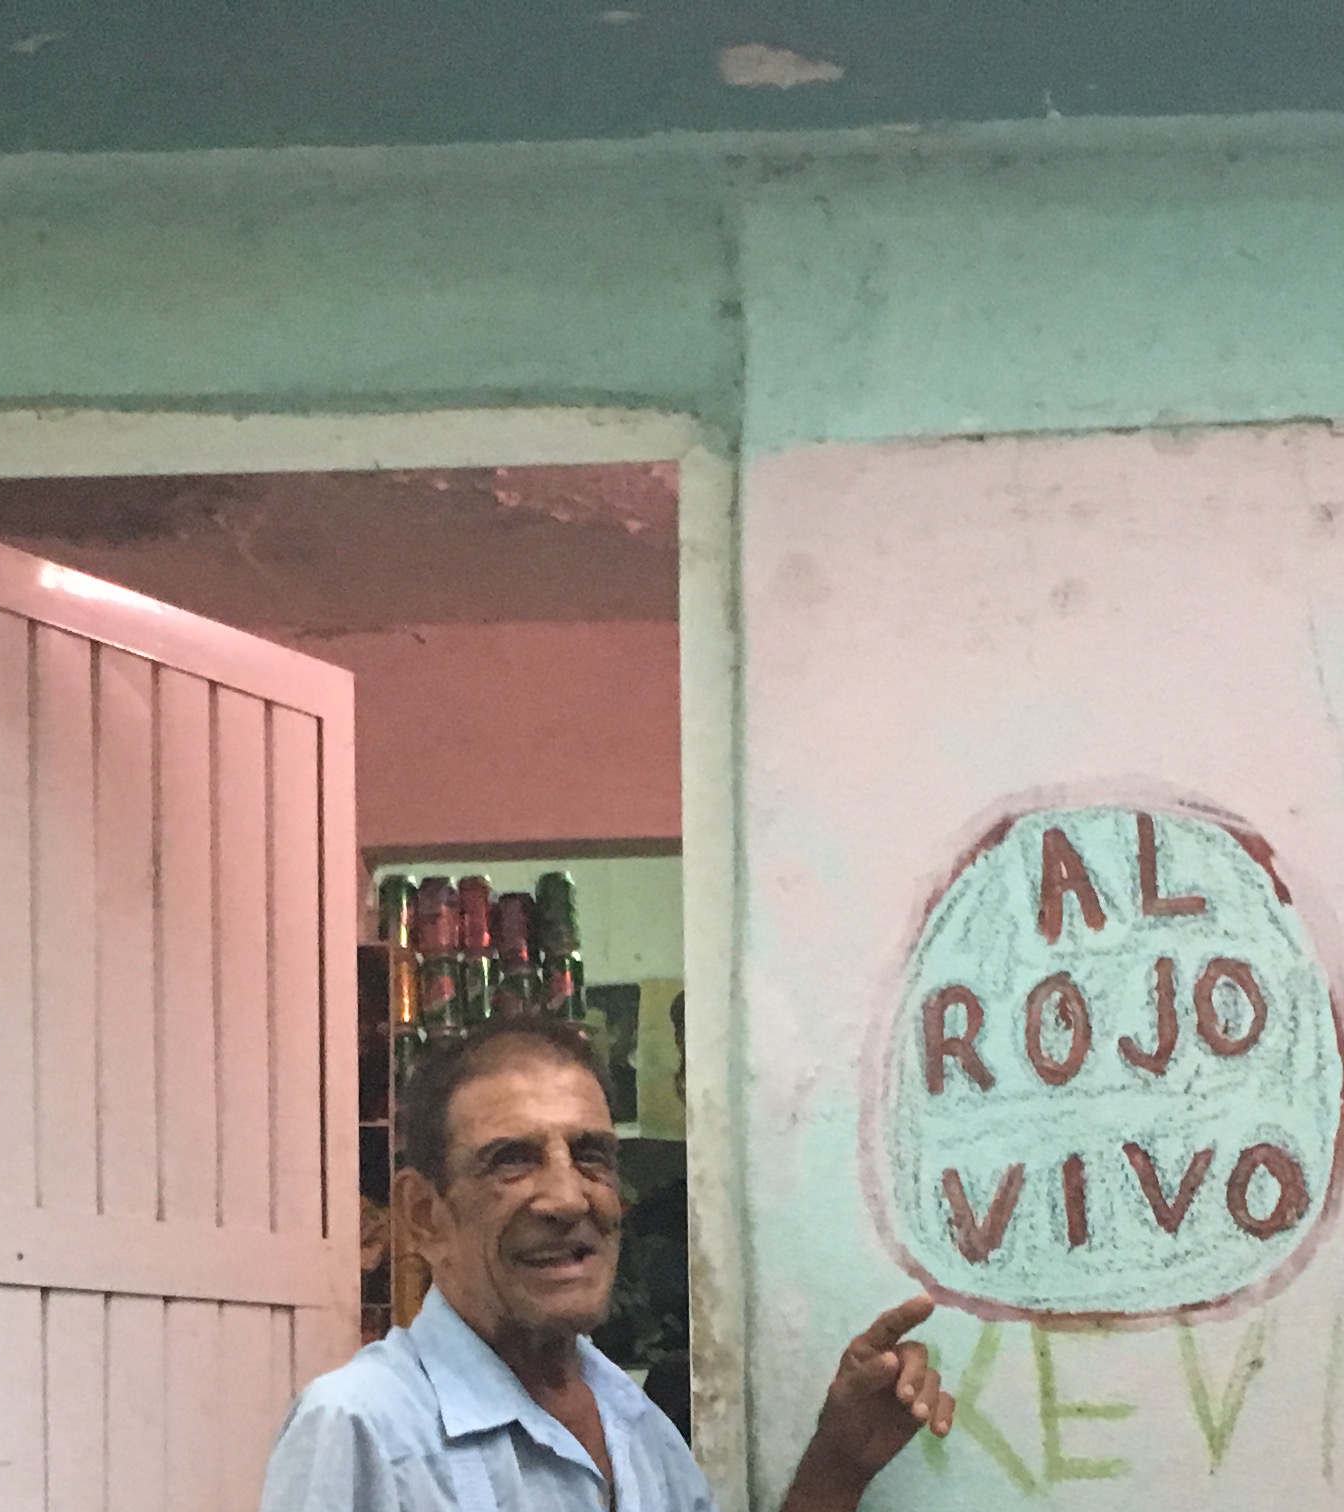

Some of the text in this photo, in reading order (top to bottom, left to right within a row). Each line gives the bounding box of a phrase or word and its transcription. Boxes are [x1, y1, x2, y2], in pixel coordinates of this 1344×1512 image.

[1036, 811, 1207, 943] AL
[922, 957, 1268, 1094] ROJO
[942, 1142, 1311, 1265] VIVO
